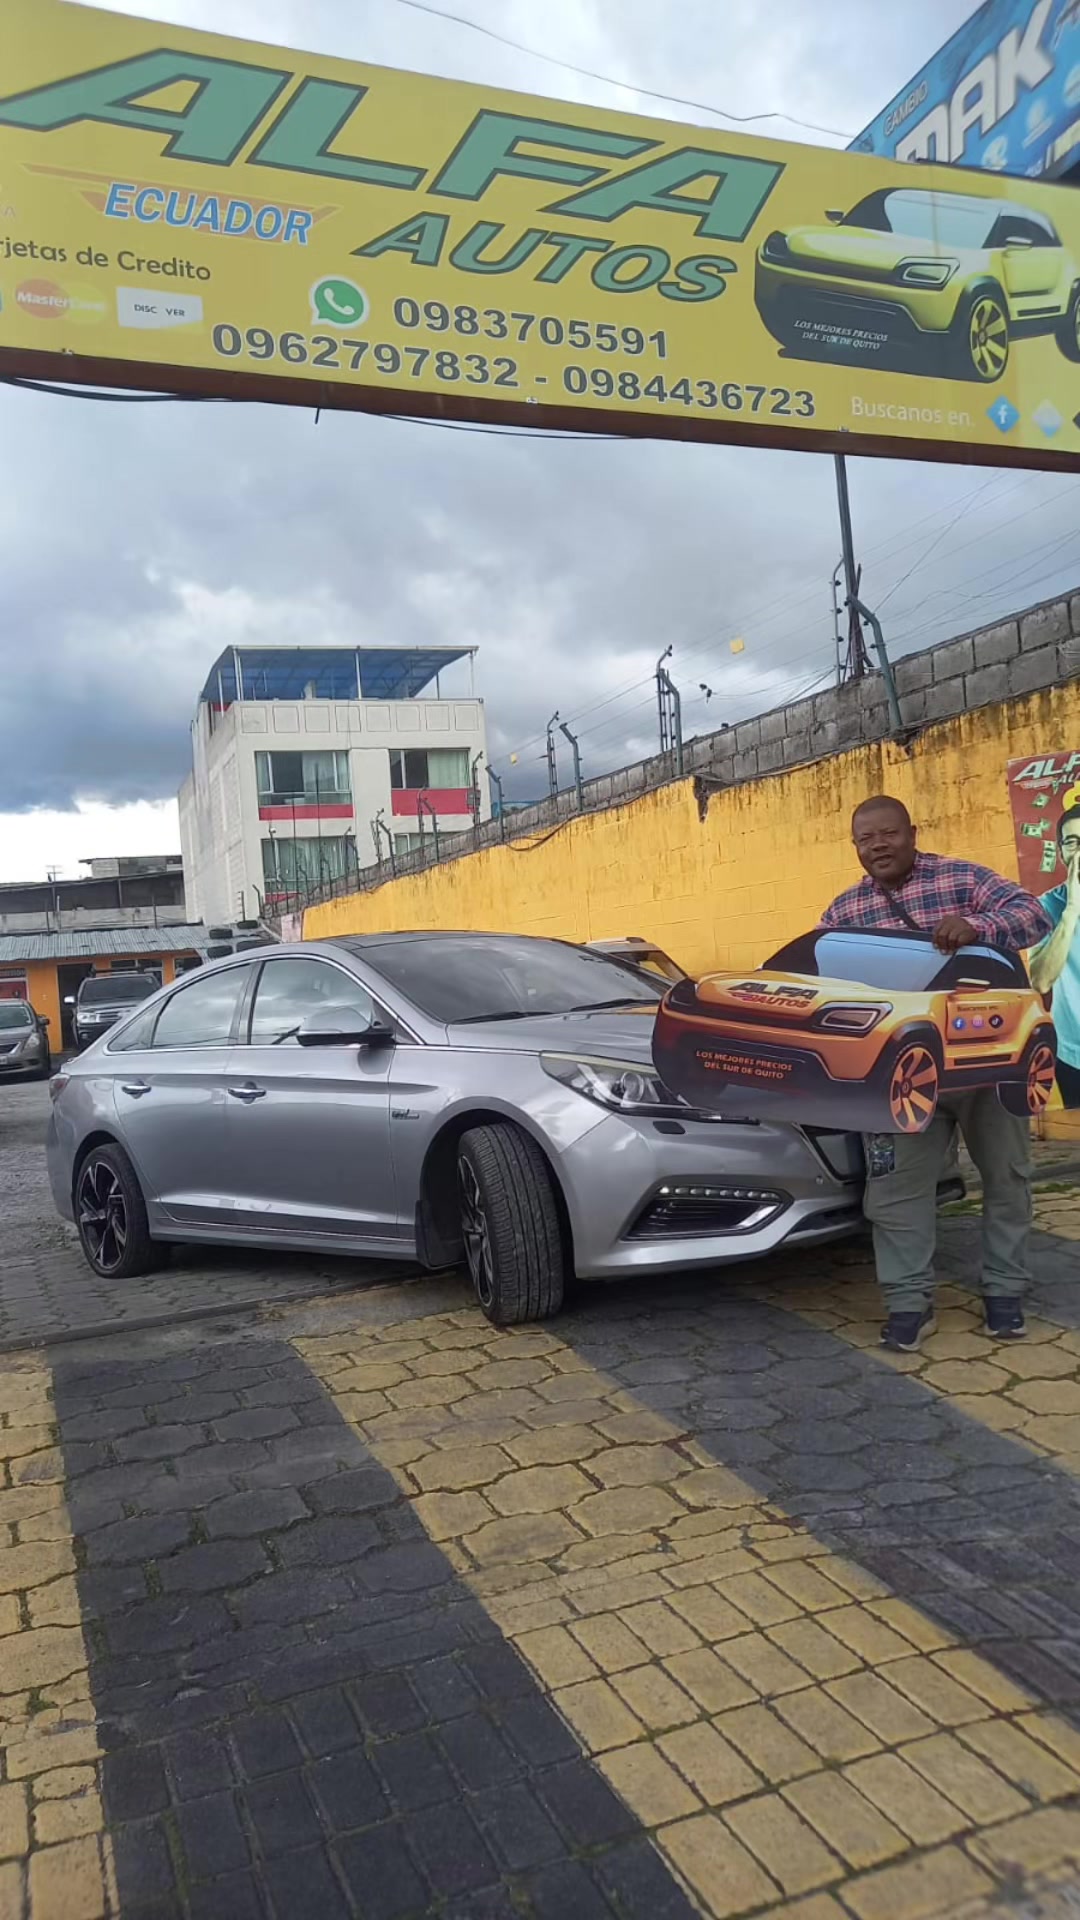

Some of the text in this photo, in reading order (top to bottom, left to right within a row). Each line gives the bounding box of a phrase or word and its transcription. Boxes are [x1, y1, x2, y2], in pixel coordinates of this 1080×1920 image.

[0, 47, 787, 243] ALFA
[104, 182, 313, 245] ECUADOR
[76, 246, 109, 268] de
[117, 250, 211, 281] Credito
[351, 211, 738, 302] AUTOS
[393, 297, 668, 359] 0983705591
[794, 320, 889, 342] LOS MEJORES PRECIOS
[802, 331, 819, 341] DEL
[853, 340, 880, 350] QUITO
[212, 322, 519, 388] 0962797832
[563, 365, 816, 418] 0984436723
[851, 396, 942, 424] Buscanos
[725, 981, 820, 1000] ALFA
[696, 1050, 792, 1071] LOS MEJORES PRECIOS
[704, 1061, 785, 1080] DEL SUR DE QUITO
